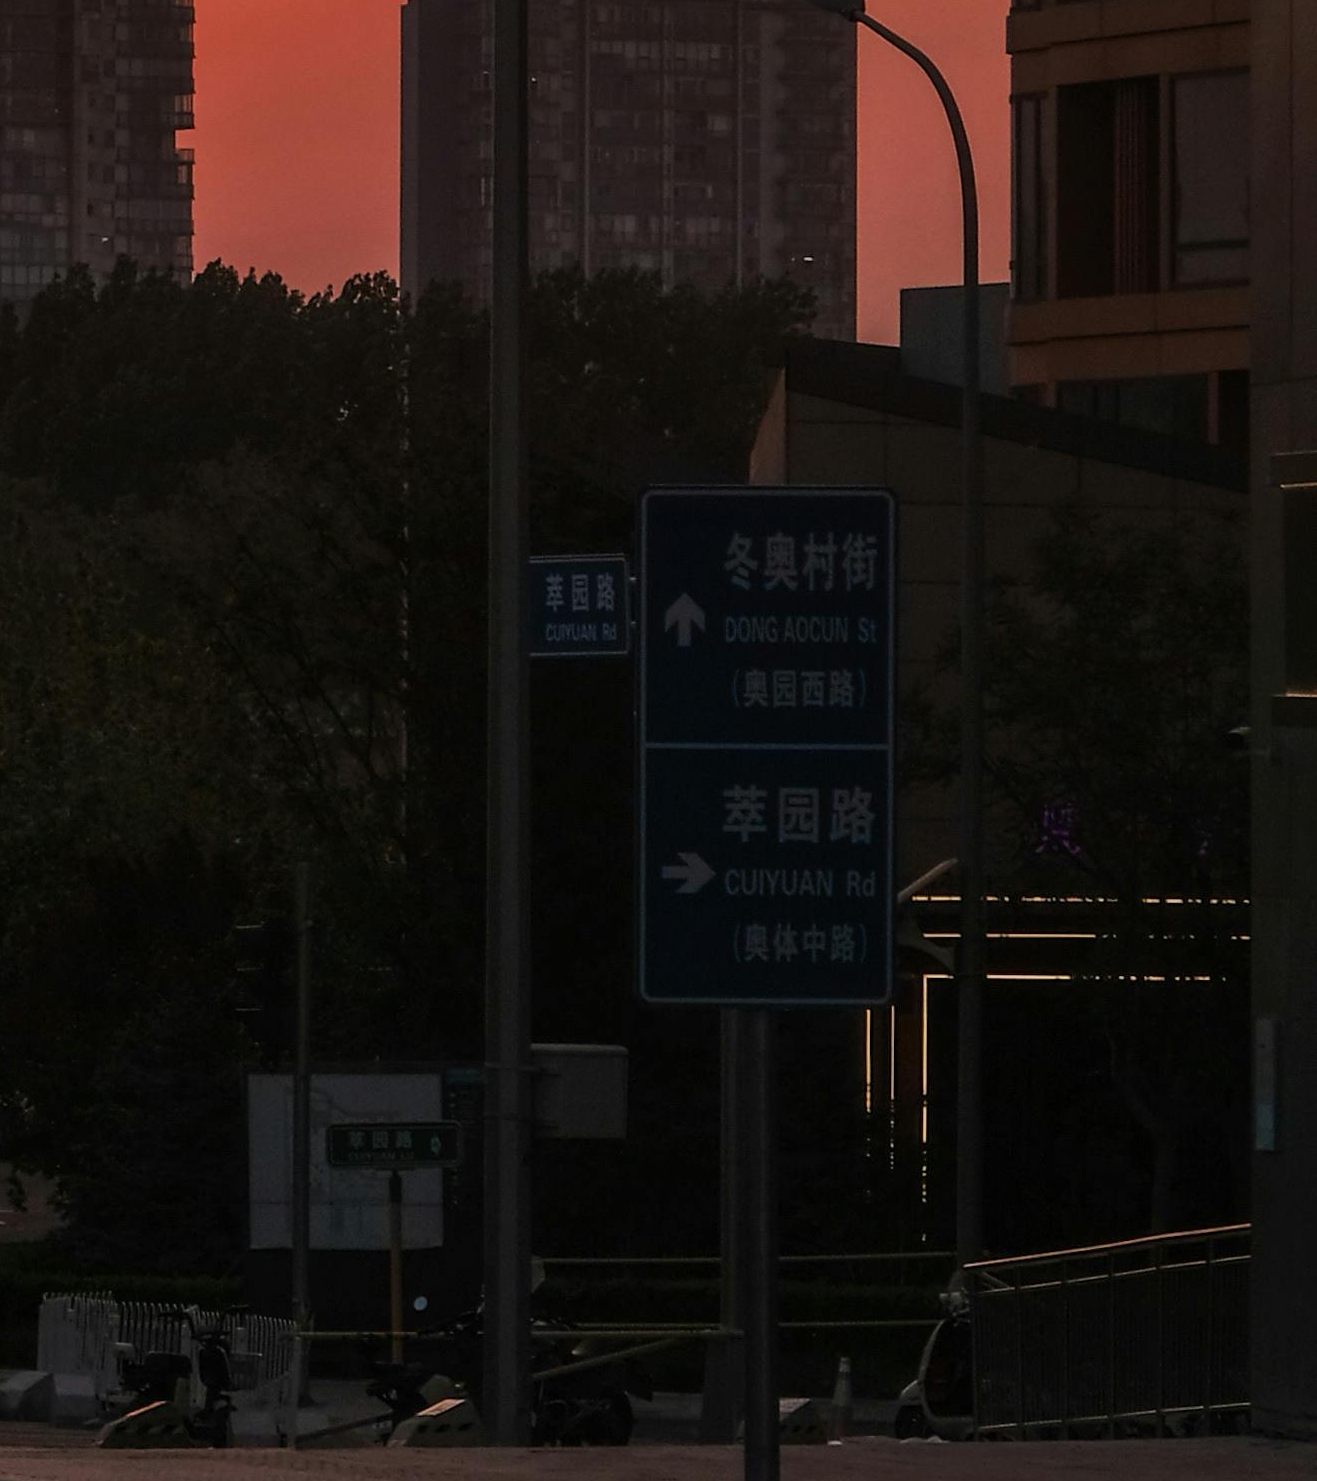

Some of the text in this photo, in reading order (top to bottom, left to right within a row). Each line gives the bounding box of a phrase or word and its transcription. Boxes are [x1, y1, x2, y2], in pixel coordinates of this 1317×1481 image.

[723, 530, 879, 591] 冬奥村街
[545, 572, 615, 612] 萃园路
[857, 618, 878, 644] St
[722, 785, 877, 844] 萃园路
[724, 869, 876, 897] CUIYUAN Rd
